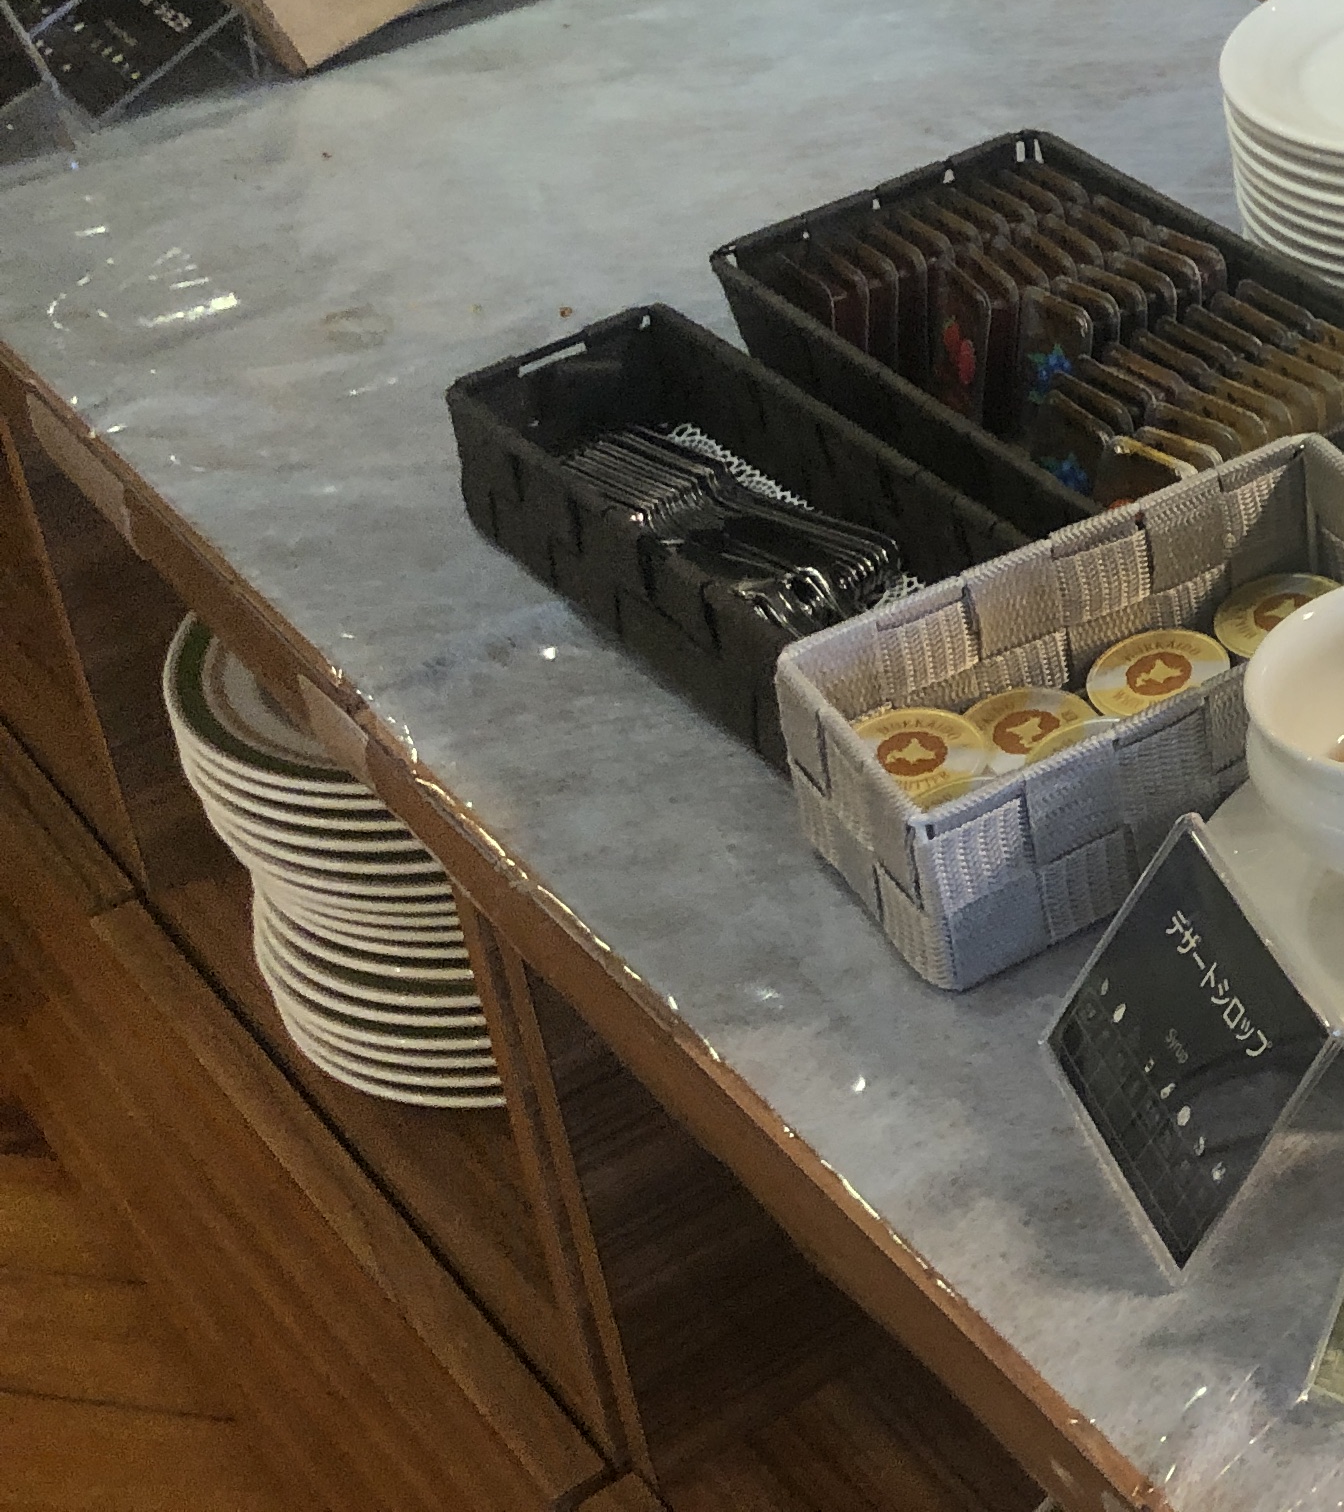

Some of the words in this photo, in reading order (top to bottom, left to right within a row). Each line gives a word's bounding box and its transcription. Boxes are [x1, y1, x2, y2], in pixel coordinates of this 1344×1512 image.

[1166, 910, 1273, 1057] デザートシロップ
[1165, 1028, 1189, 1065] Syrup
